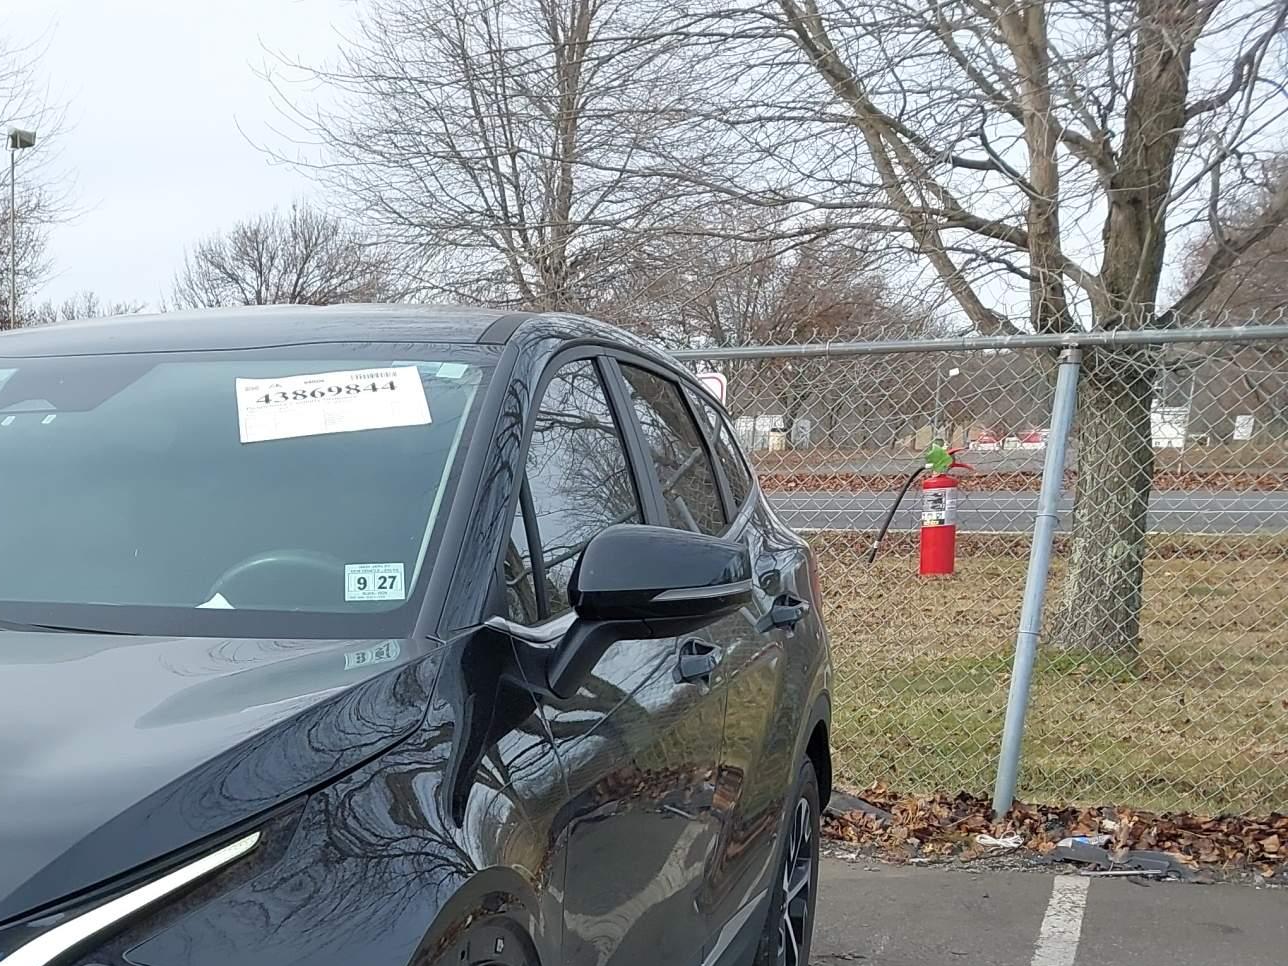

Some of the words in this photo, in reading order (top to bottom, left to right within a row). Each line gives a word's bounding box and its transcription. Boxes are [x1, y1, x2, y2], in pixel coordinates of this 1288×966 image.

[255, 380, 398, 405] 43869844
[357, 576, 368, 591] 9
[377, 575, 397, 590] 27
